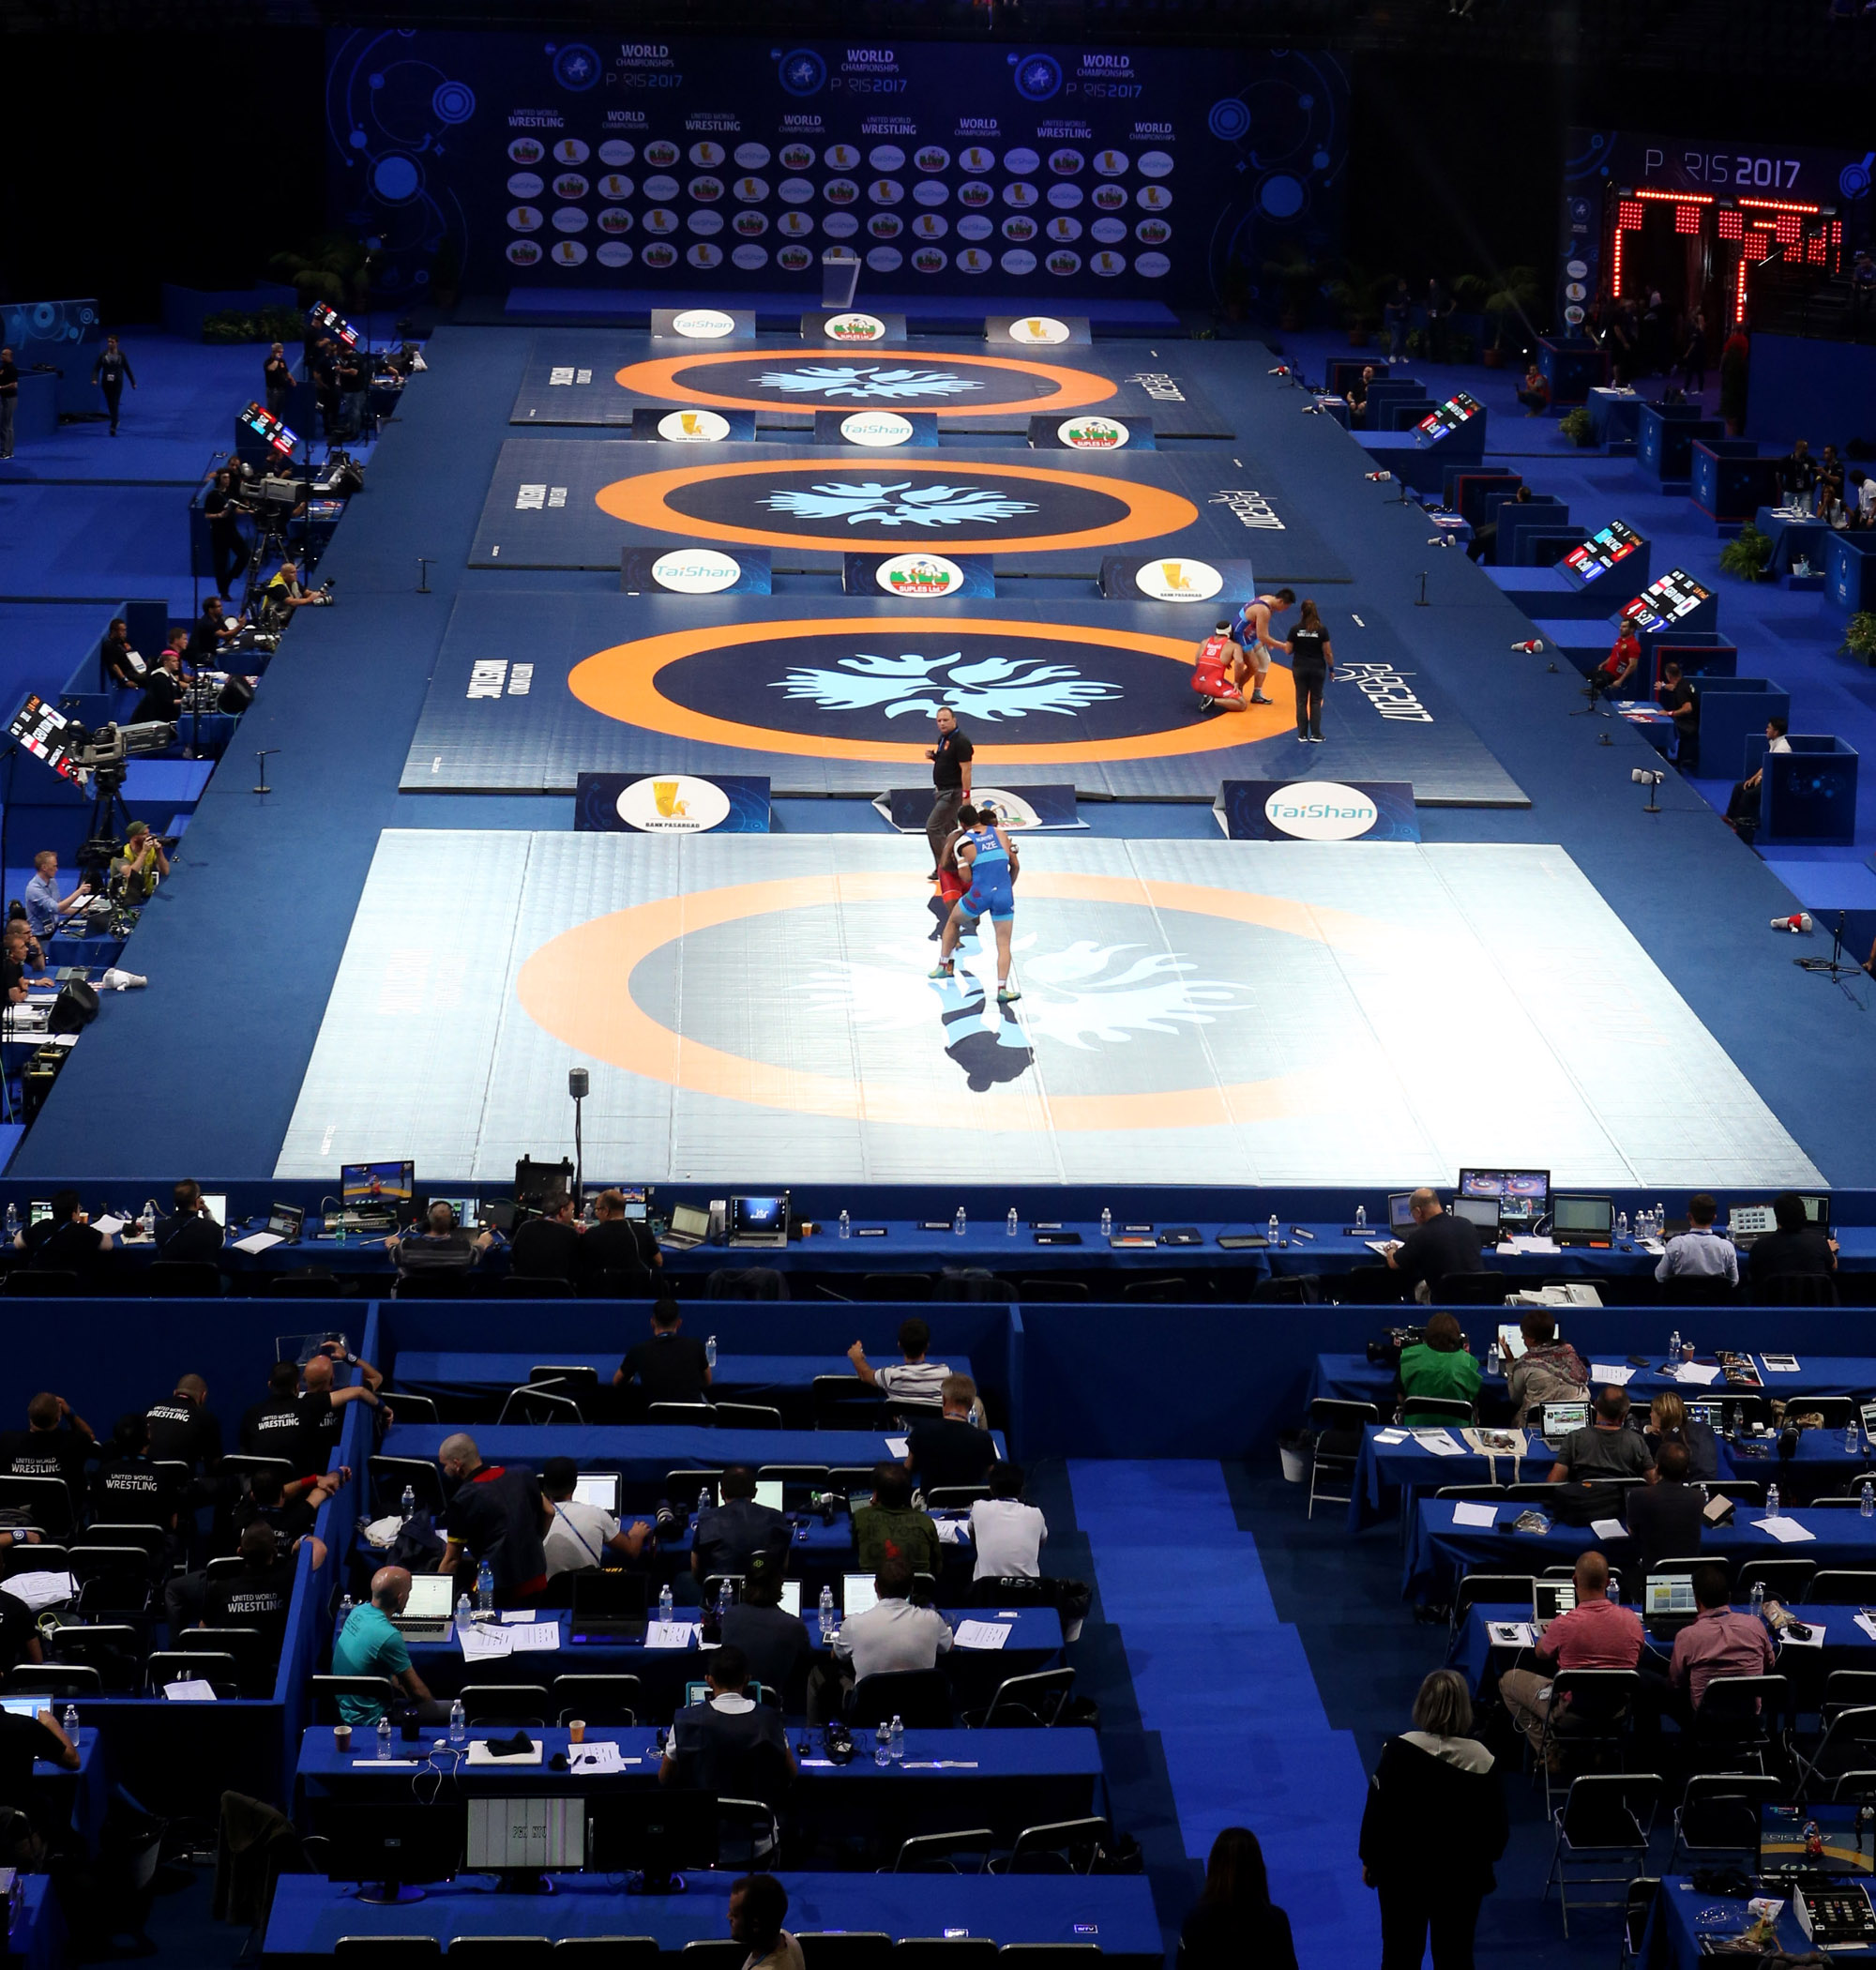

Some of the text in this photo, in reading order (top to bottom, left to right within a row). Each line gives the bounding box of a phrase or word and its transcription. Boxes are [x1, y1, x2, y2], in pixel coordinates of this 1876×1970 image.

[622, 45, 668, 57] WORLD
[847, 50, 893, 62] WORLD
[616, 58, 674, 68] CHAMPIONSHIPS
[1083, 55, 1129, 68] WORLD
[841, 63, 899, 73] CHAMPIONSHIPS
[1077, 68, 1134, 78] CHAMPIONSHIPS
[508, 116, 564, 128] WRESTLING
[607, 111, 645, 122] WORLD
[784, 115, 821, 126] WORLD
[685, 120, 741, 132] WRESTLING
[862, 124, 916, 135] WRESTLING
[960, 118, 997, 129] WORLD
[1135, 123, 1172, 133] WORLD
[1037, 127, 1091, 139] WRESTLING
[1736, 158, 1801, 188] 2017
[676, 318, 733, 329] TaiShan
[844, 424, 911, 435] TaiShan
[656, 565, 737, 577] TaiShan
[1624, 601, 1644, 616] 4
[1633, 609, 1656, 627] 5:27
[1645, 619, 1666, 635] 2
[1270, 804, 1372, 818] TaiShan
[982, 841, 998, 851] AZE
[147, 1409, 190, 1422] WRESTLING
[258, 1418, 299, 1431] WRESTLING
[106, 1480, 157, 1491] WRESTLING
[228, 1599, 283, 1613] WRESTLING
